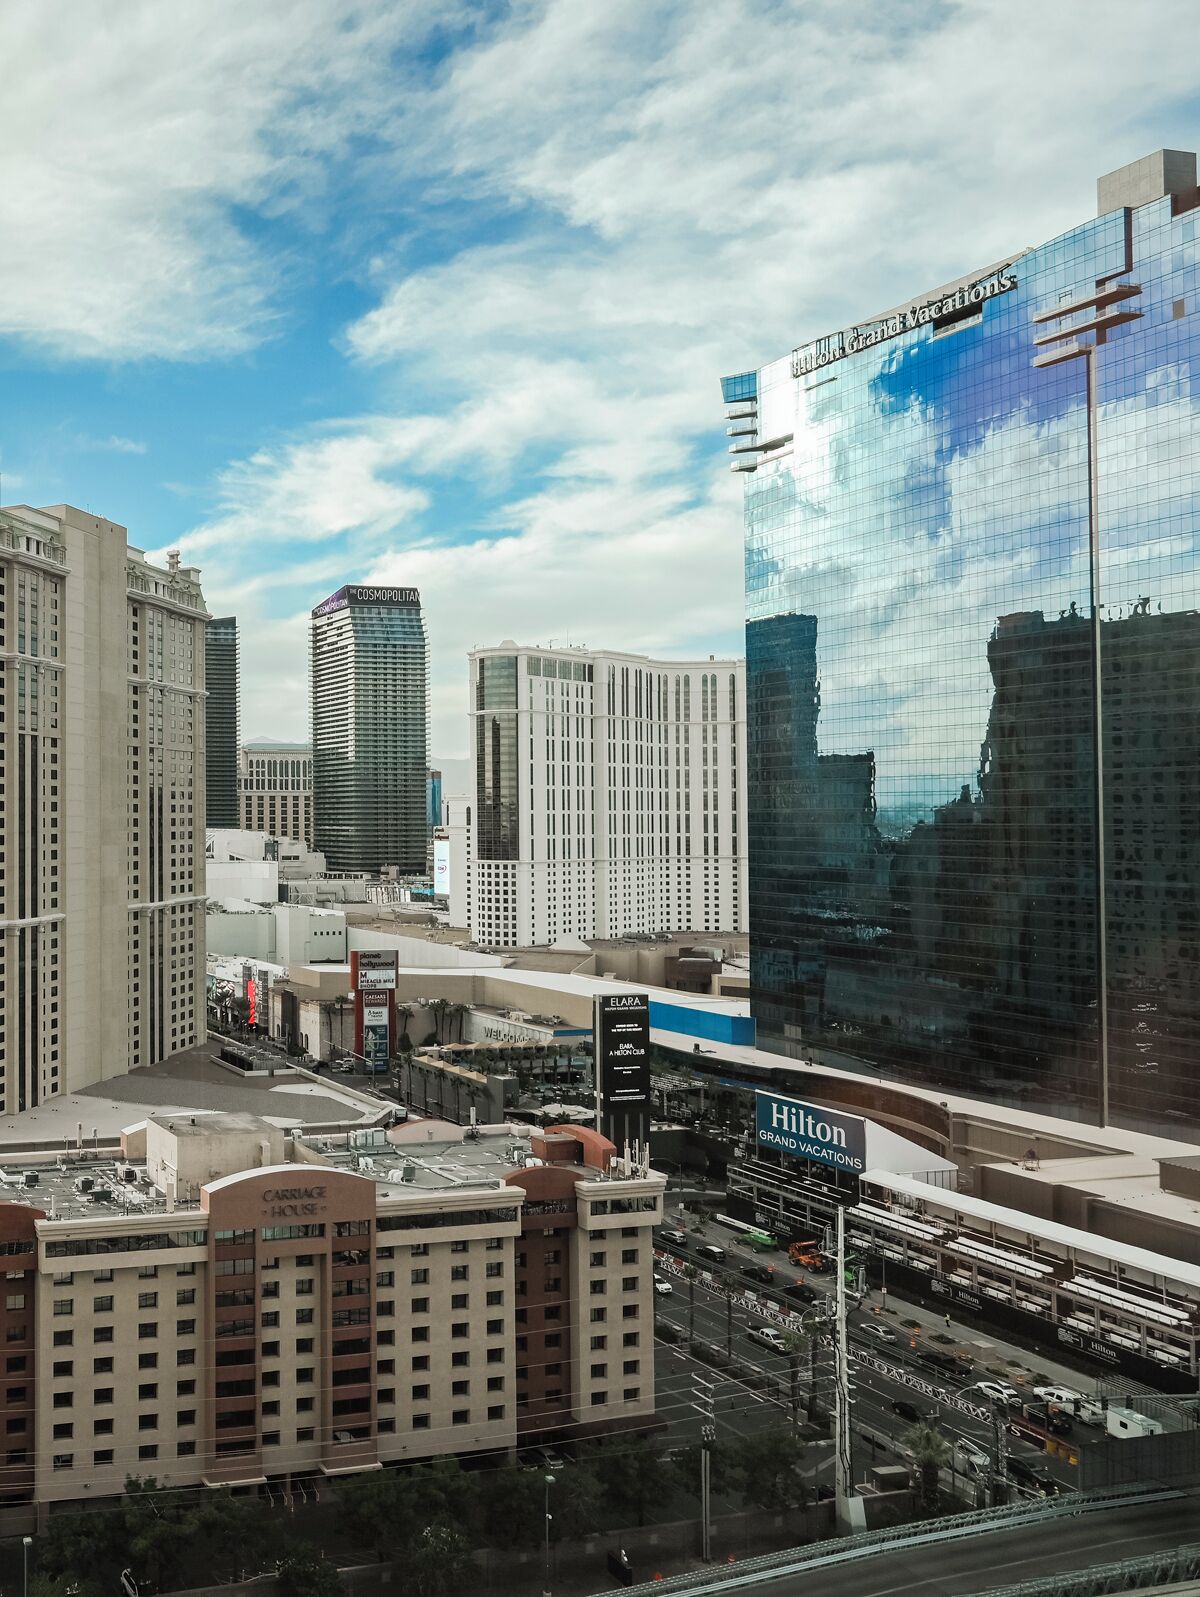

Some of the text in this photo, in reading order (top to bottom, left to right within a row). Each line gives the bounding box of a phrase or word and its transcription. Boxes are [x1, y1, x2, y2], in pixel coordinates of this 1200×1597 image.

[792, 274, 1012, 378] Hilton Grand Vacations
[357, 588, 420, 602] COSMOPOLITAN
[360, 960, 394, 969] hollywood
[610, 997, 641, 1007] ELARA
[771, 1103, 847, 1148] Hilton
[759, 1130, 862, 1169] GRAND VACATIONS
[263, 1186, 327, 1202] CARRIAGE
[271, 1203, 318, 1217] HOUSE
[958, 1290, 980, 1305] Hilton
[1091, 1341, 1117, 1358] Hilton
